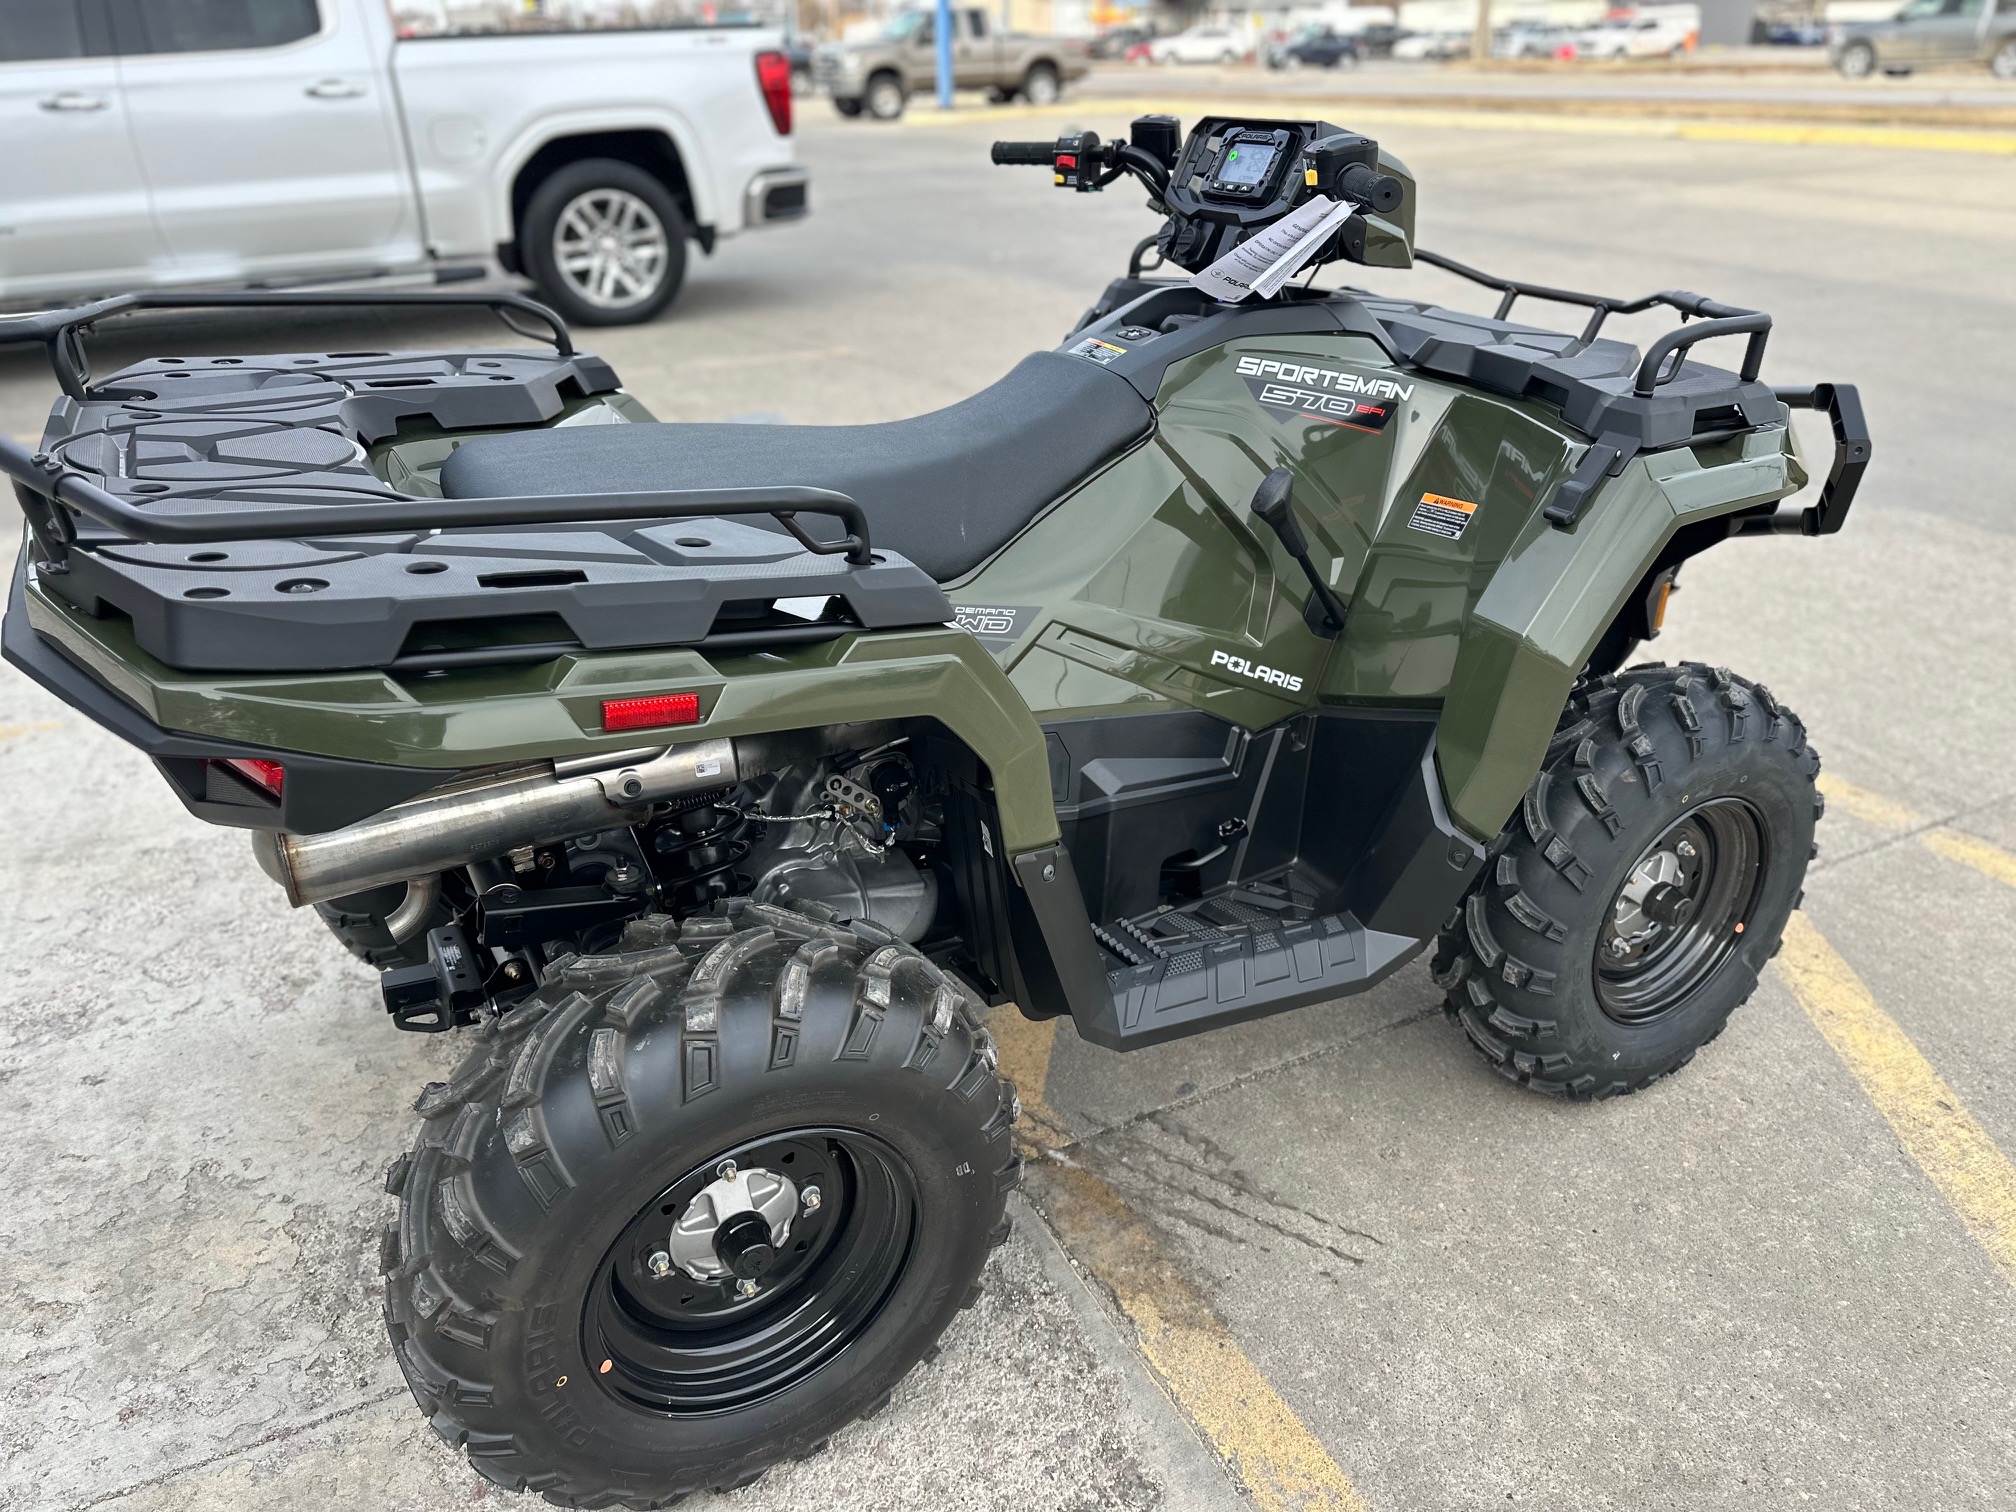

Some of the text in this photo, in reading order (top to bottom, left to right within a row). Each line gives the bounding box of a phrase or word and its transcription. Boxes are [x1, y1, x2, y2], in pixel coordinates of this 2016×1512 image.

[1223, 276, 1250, 290] POLAR
[1235, 356, 1415, 402] SPORTSMAN
[1259, 383, 1386, 417] 570 EFI
[1439, 499, 1464, 510] WARNING
[954, 606, 1017, 616] DEMAND
[1210, 650, 1304, 692] POLARIS
